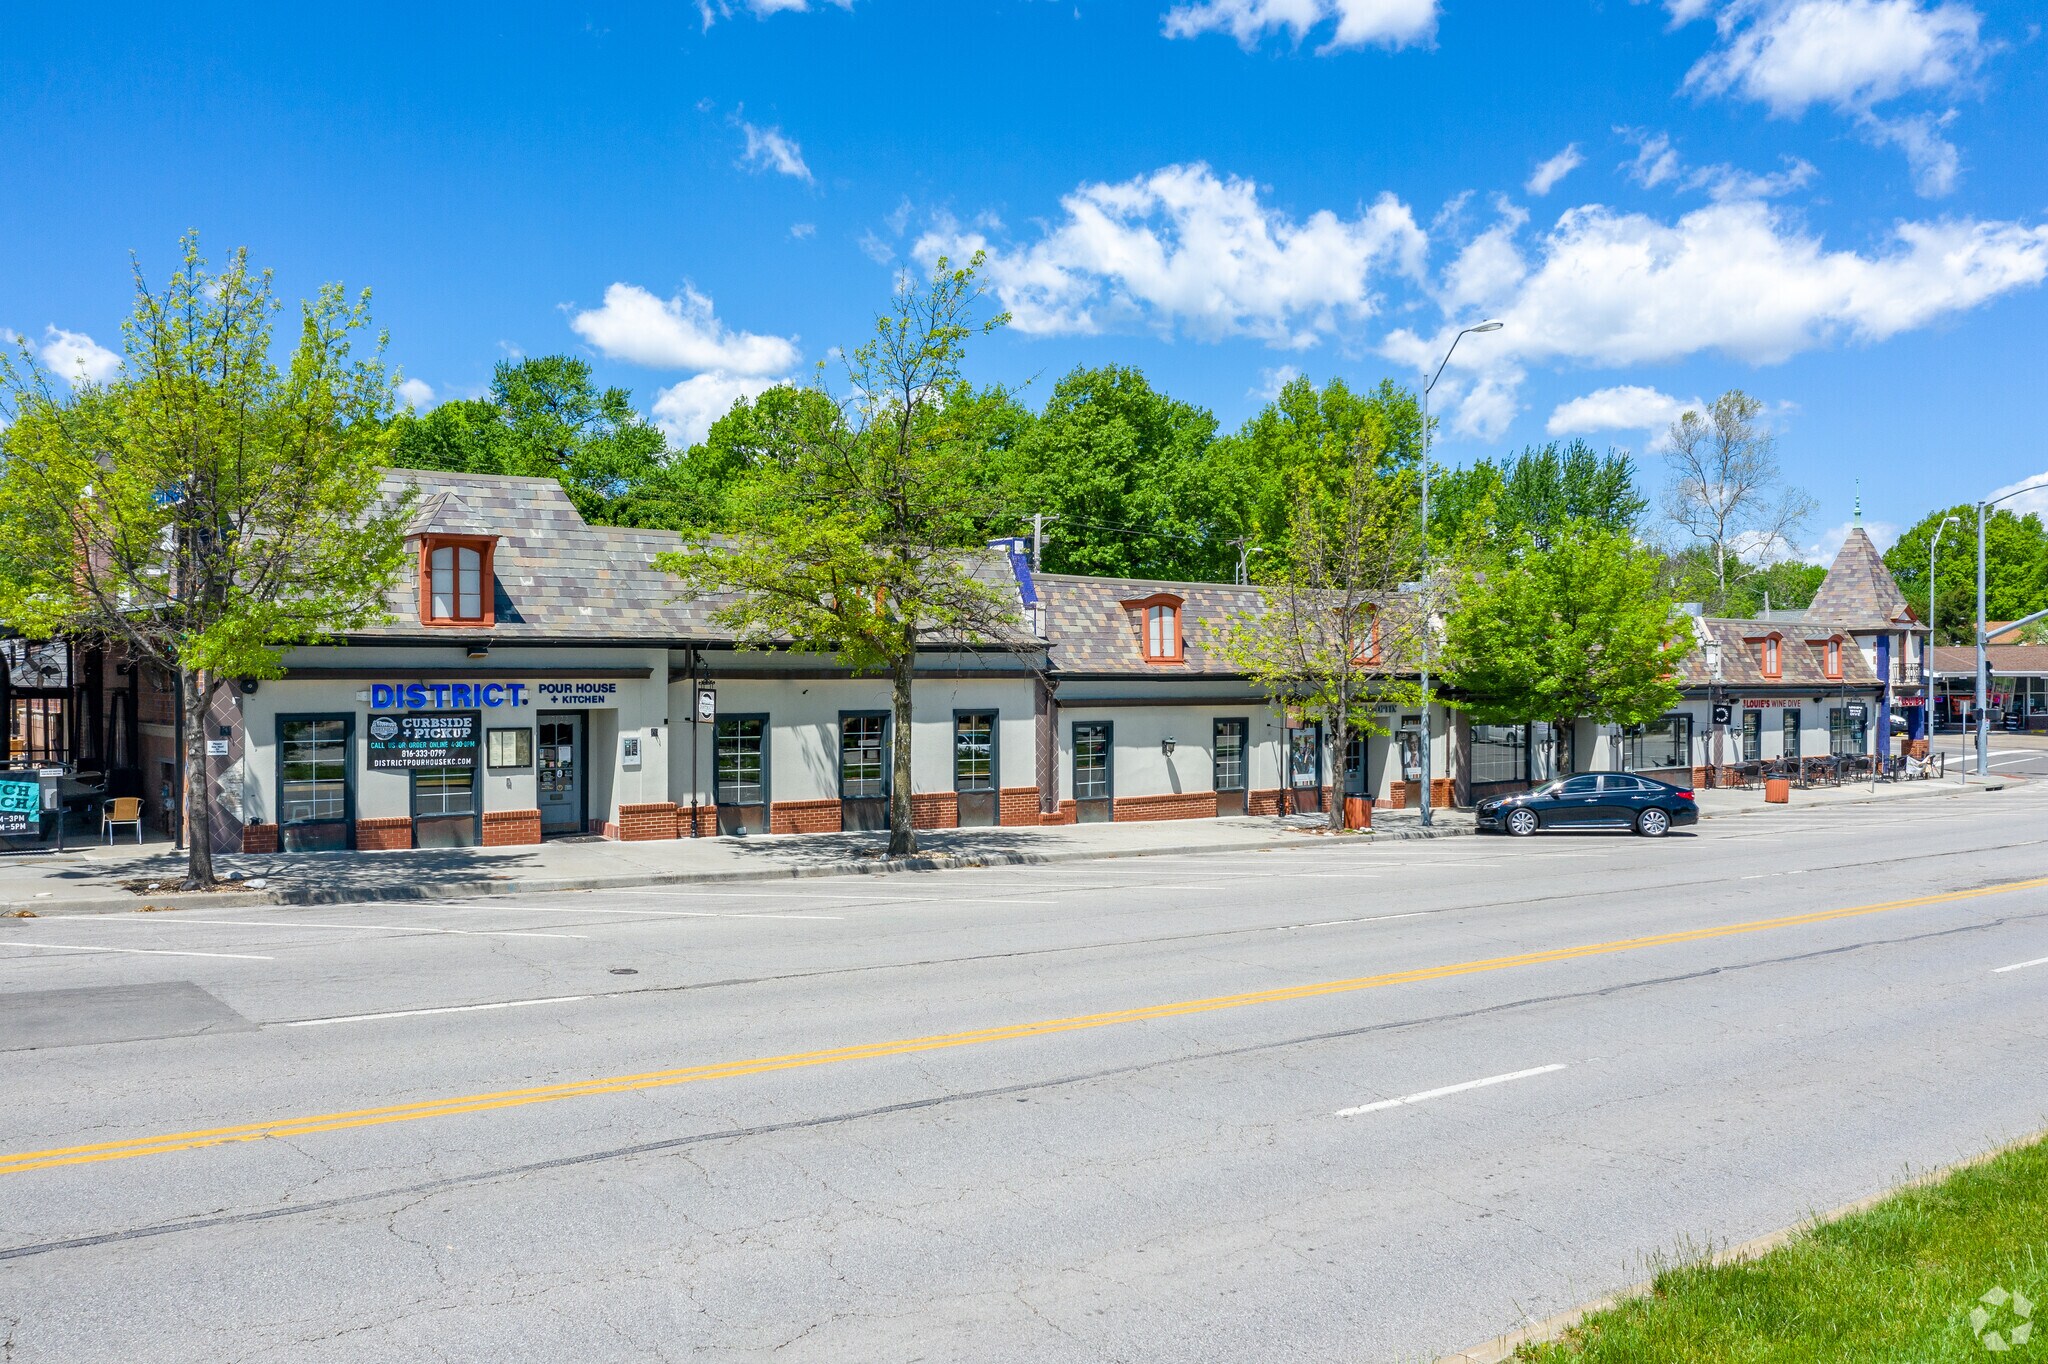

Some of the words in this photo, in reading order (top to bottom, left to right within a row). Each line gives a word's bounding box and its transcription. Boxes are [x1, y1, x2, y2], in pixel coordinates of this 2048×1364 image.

[538, 683, 573, 694] POUR
[575, 683, 617, 693] HOUSE
[562, 695, 605, 704] KITCHEN
[1746, 699, 1770, 708] LOUIE'S
[1771, 699, 1786, 708] WINE
[1787, 699, 1801, 707] DIVE
[402, 717, 472, 728] CURBSIDE
[414, 727, 471, 739] PICKUP
[370, 741, 385, 749] CALL
[387, 741, 395, 749] US
[398, 741, 406, 749] OR
[408, 741, 427, 749] ORDER
[429, 740, 449, 748] ONLINE
[401, 749, 446, 758] 816-333-0799
[374, 758, 472, 767] DISTRICTPOURHOUSEKC.COM
